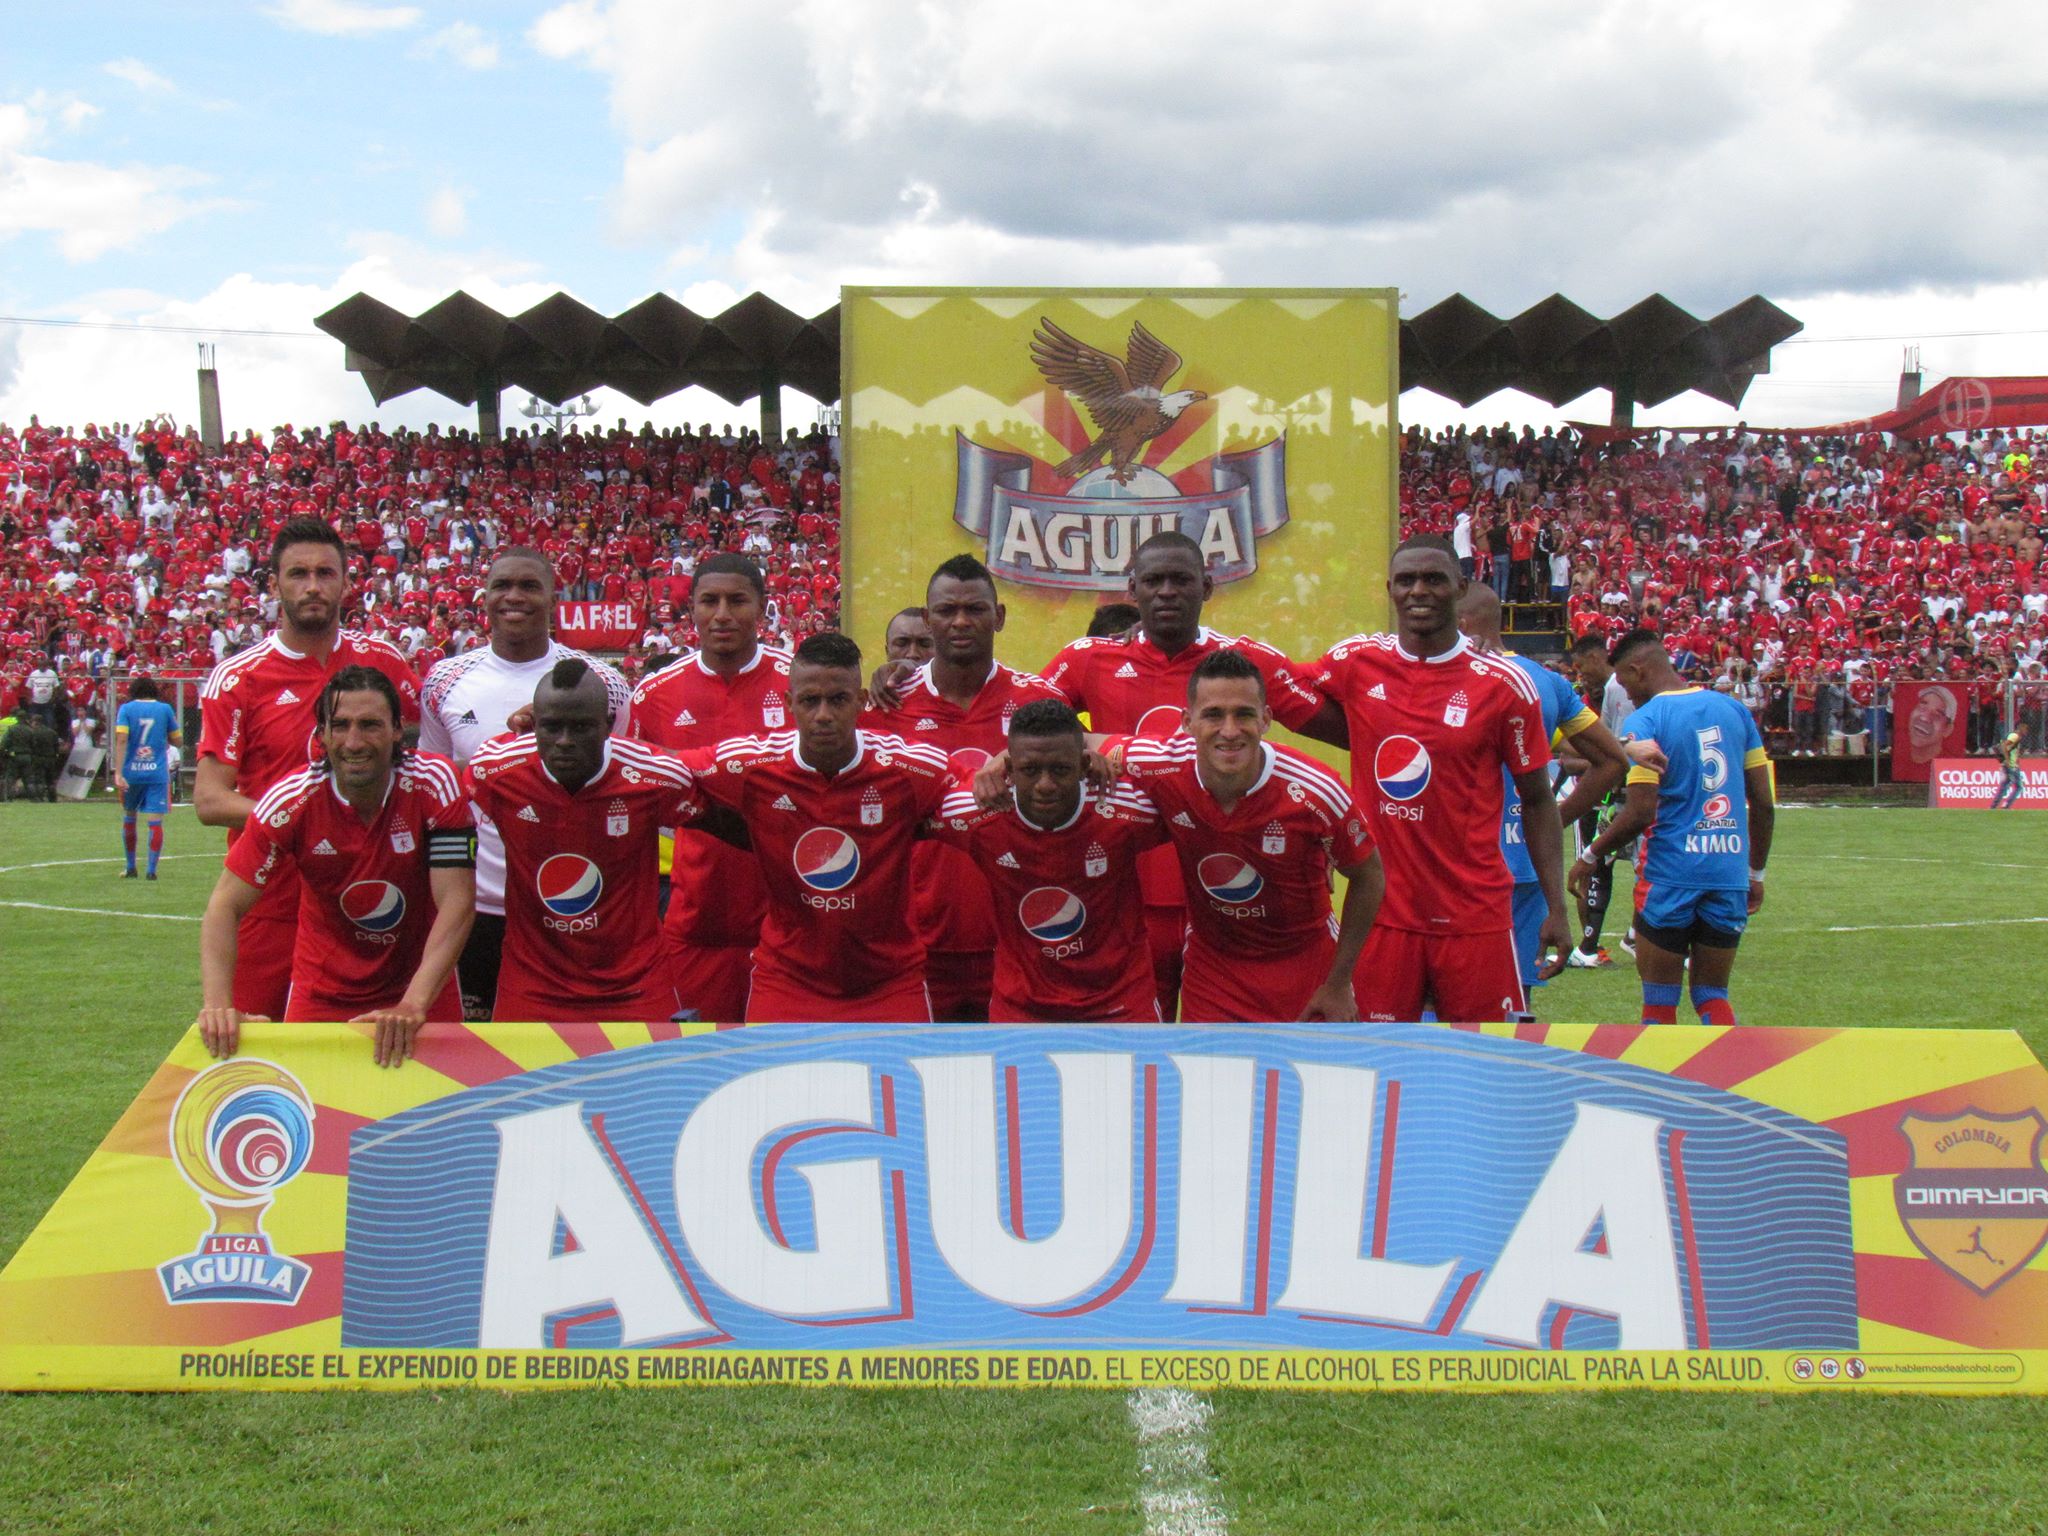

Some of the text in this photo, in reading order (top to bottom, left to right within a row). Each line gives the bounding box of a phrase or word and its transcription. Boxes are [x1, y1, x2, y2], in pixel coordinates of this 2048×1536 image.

[998, 504, 1243, 573] AGUA
[560, 605, 586, 630] LA
[139, 718, 155, 744] 7
[1696, 725, 1728, 792] 5
[1939, 770, 2030, 785] COLOMA
[1940, 786, 1969, 798] PAGO
[1695, 818, 1738, 830] OLPATRIA
[1685, 833, 1742, 854] KIMO
[544, 912, 599, 934] pepsi
[355, 931, 400, 945] pep
[1041, 937, 1084, 960] epsi
[1934, 1128, 2011, 1153] COLOMBIA
[478, 1052, 1690, 1351] AGUILA
[1906, 1187, 2048, 1205] DIMAYOR
[211, 1237, 260, 1253] LIGA
[173, 1256, 294, 1293] AGUILA
[180, 1348, 1770, 1381] PROHÍBESE EL EXPENDIO DE BEBIDAS EMBRIAGANTES A MENORES DE EDAD. EL EXCESO DE ALCOHOL ES PERJUDICIAL PARA LA SALUD.
[1868, 1363, 2016, 1374] www.hablemosdealcohol.com
